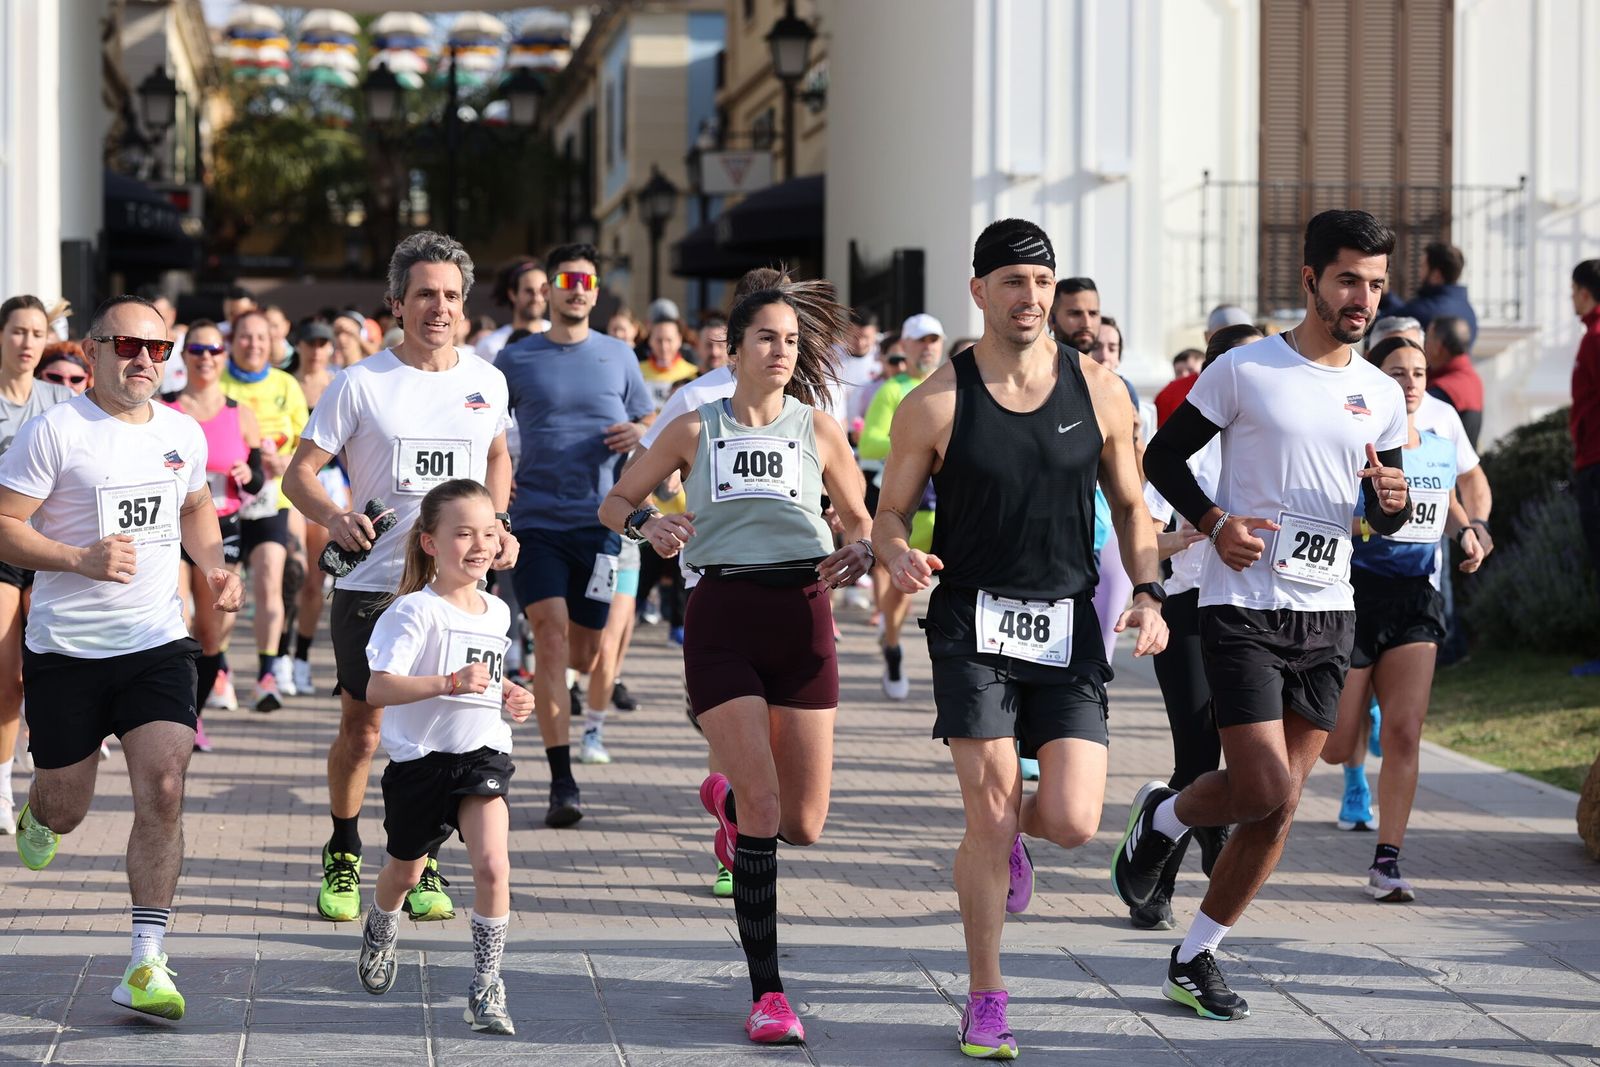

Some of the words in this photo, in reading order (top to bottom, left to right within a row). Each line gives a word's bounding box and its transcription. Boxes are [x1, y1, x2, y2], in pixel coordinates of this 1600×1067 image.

[415, 451, 454, 477] 501
[732, 450, 783, 478] 408
[118, 495, 162, 529] 357
[1291, 531, 1339, 567] 284
[998, 609, 1050, 643] 488
[466, 647, 502, 683] 503
